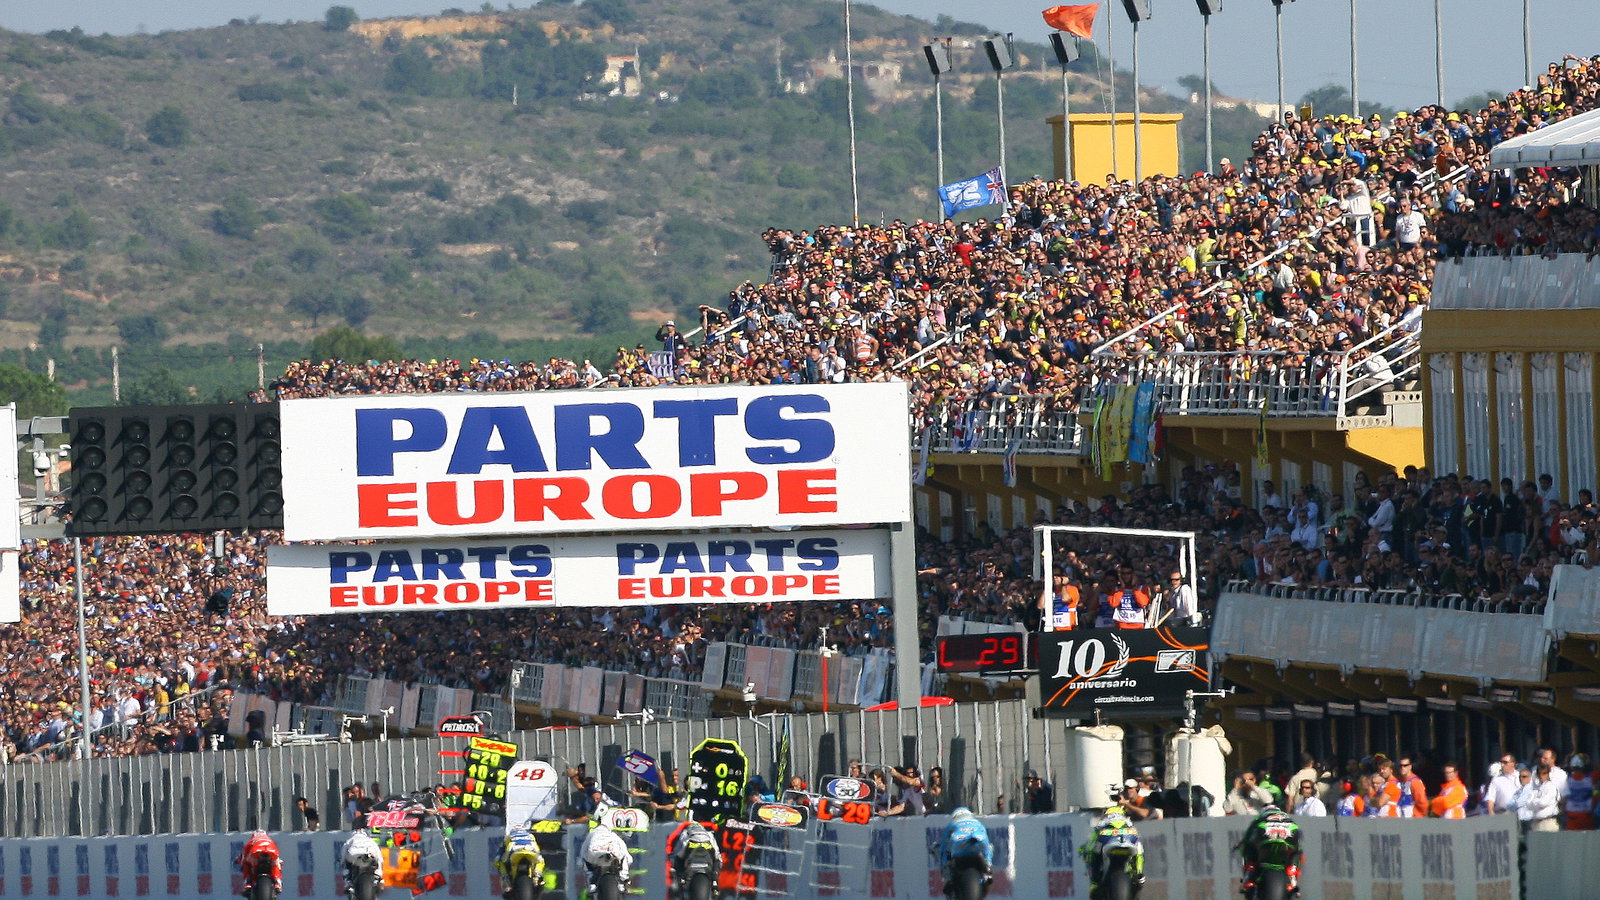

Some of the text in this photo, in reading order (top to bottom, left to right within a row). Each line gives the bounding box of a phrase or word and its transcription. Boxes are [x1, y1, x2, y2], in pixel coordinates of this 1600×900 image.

[355, 394, 836, 477] PARTS
[357, 468, 838, 528] EUROPE
[329, 545, 552, 584] PARTS
[617, 537, 840, 576] PARTS
[329, 580, 553, 608] EUROPE
[617, 575, 840, 599] EUROPE
[940, 637, 1018, 668] L 29
[1051, 638, 1106, 679] 10
[1069, 677, 1137, 690] aniversario
[514, 768, 546, 781] 48
[717, 780, 739, 797] 16
[817, 798, 833, 821] L
[842, 801, 872, 825] 29
